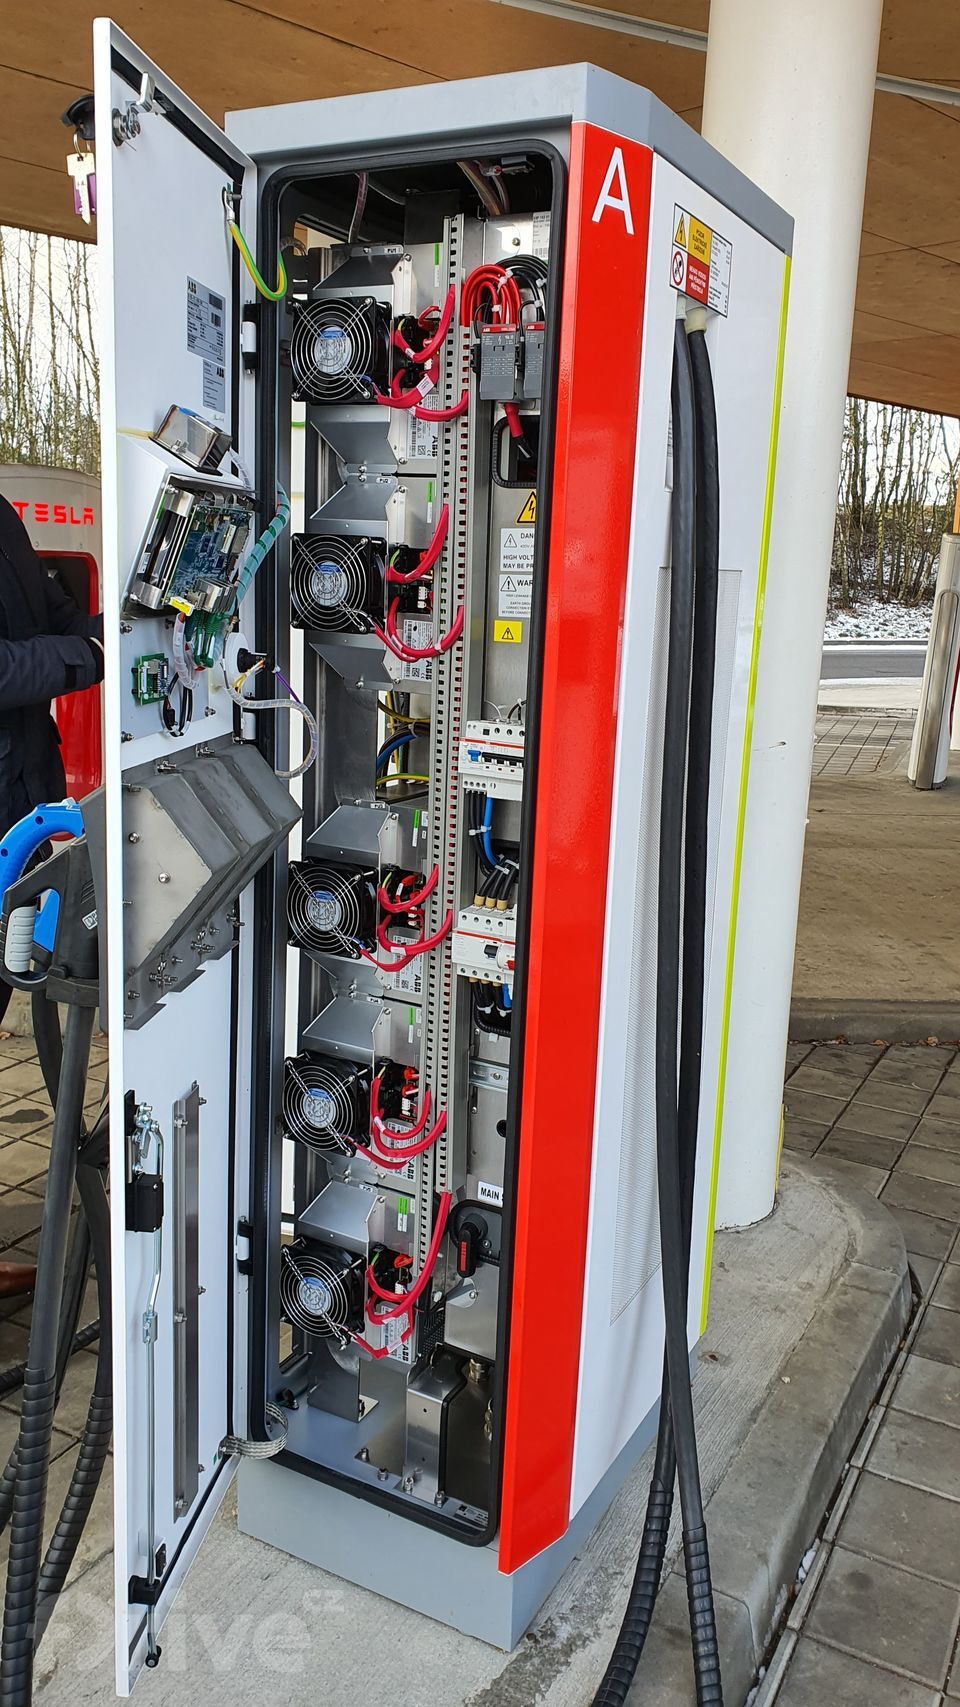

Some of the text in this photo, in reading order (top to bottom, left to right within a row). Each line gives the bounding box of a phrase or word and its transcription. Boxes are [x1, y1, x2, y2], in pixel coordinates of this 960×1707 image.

[592, 146, 634, 235] A
[12, 501, 94, 526] TESLA
[414, 974, 422, 993] ABB
[407, 1160, 415, 1180] ABB
[481, 1187, 500, 1200] MAIN
[402, 1343, 410, 1362] ABB
